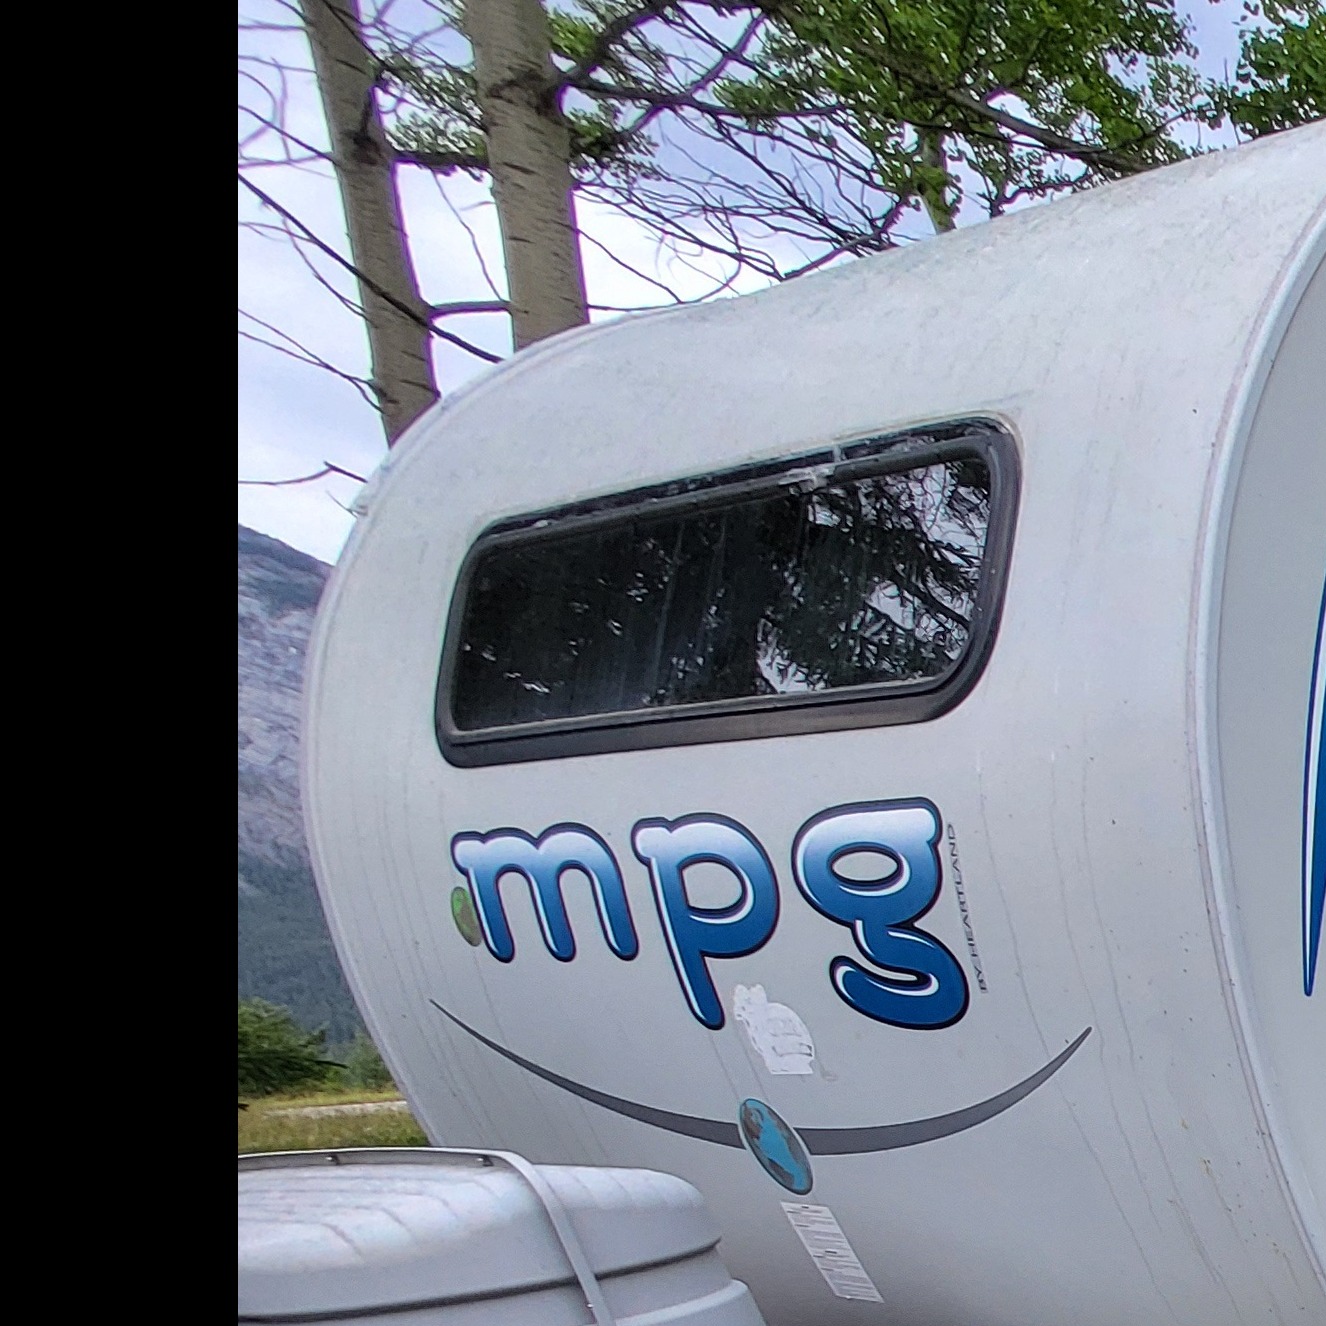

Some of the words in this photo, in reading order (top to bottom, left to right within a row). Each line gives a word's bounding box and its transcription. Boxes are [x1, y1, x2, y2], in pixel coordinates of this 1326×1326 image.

[450, 797, 970, 1030] mpg
[947, 823, 979, 957] HEARTLAND
[974, 964, 988, 992] BY
